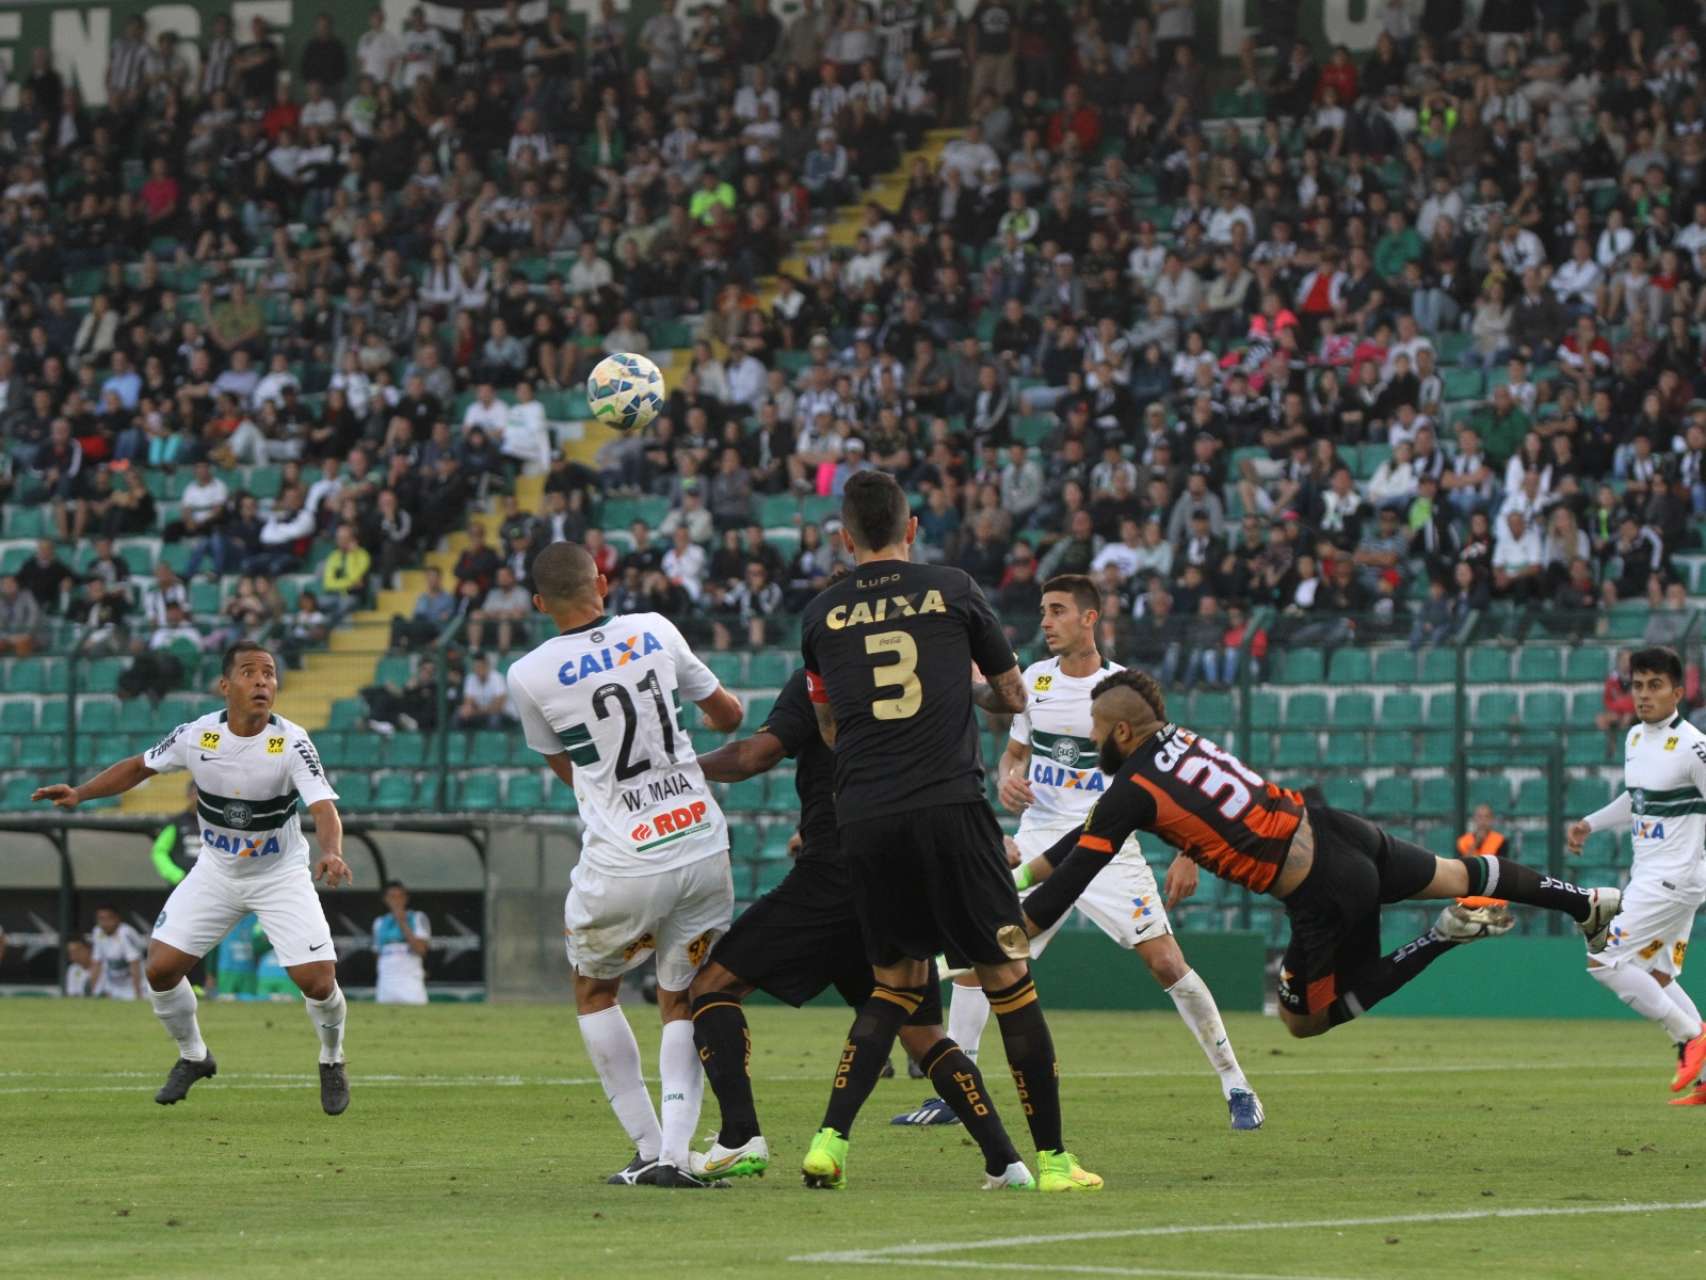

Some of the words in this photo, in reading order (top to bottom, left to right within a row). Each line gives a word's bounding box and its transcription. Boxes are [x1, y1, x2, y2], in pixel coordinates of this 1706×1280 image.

[856, 573, 900, 589] LUPO
[826, 589, 947, 630] CAIXA
[558, 632, 664, 686] CAIXA
[865, 630, 923, 720] 3
[204, 732, 220, 743] 99
[269, 737, 285, 749] 99
[592, 669, 679, 782] 21
[622, 789, 647, 812] W.
[648, 773, 693, 801] MAIA
[1033, 764, 1105, 792] CAIXA
[653, 800, 707, 836] RDP
[203, 828, 280, 858] CAIXA
[952, 1071, 989, 1117] LUPO
